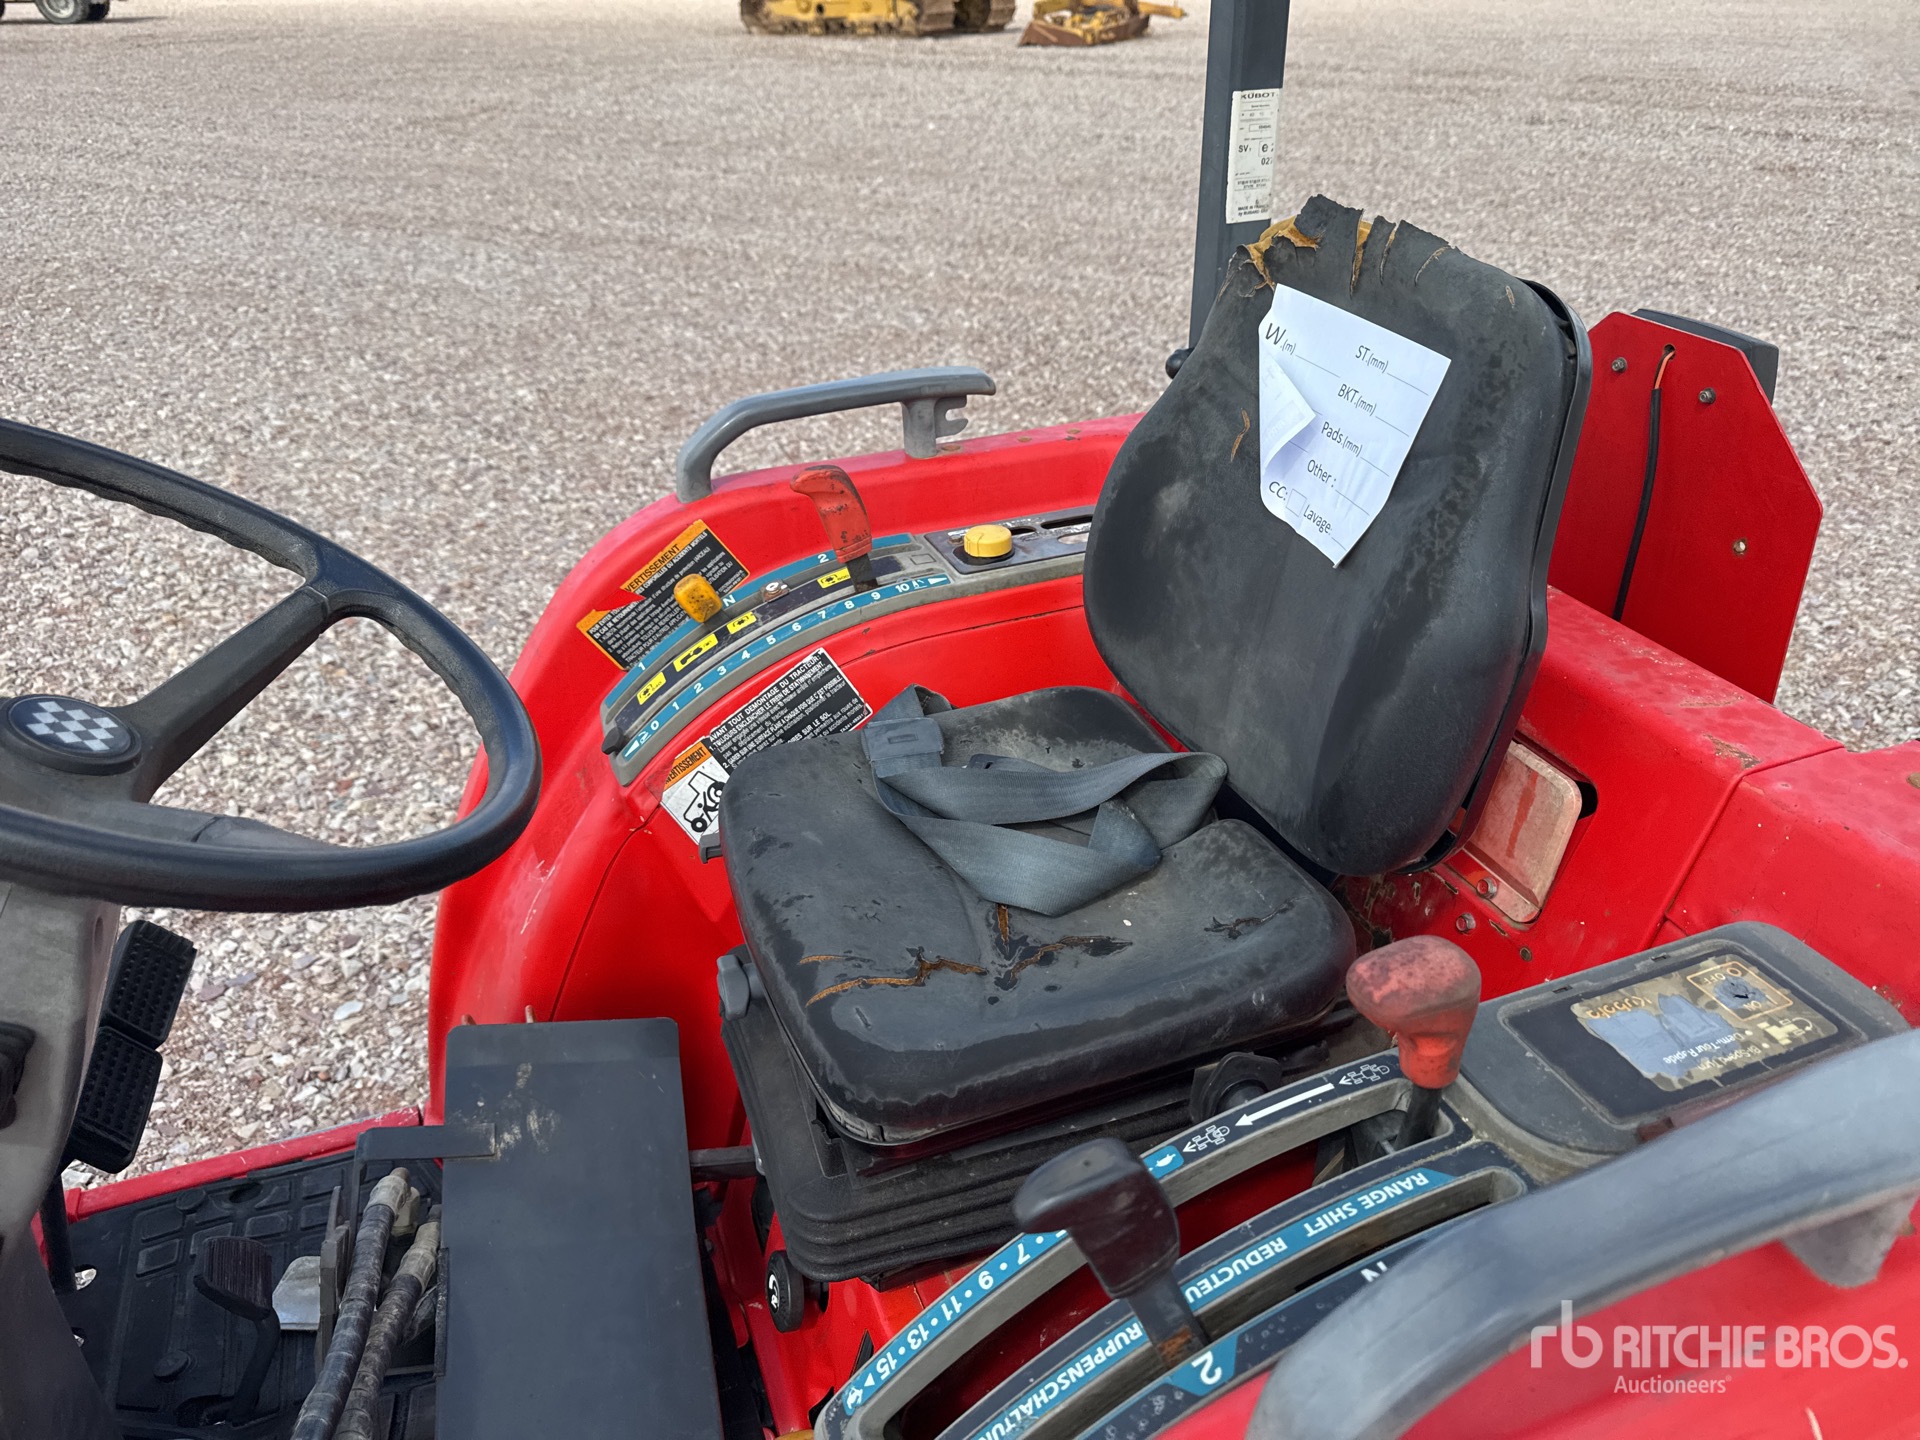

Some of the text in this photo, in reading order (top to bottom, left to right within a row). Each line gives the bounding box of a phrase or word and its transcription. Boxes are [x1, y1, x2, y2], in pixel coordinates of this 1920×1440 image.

[1307, 459, 1332, 484] Other
[625, 543, 681, 592] VERTISSEMENT
[722, 594, 736, 607] N
[817, 553, 830, 563] 2
[650, 583, 910, 731] 0 1 2 3 4 5 6 7 8 9 10
[708, 724, 728, 742] AVANT
[727, 712, 744, 727] TOUT
[744, 685, 779, 714] DEMONTAGE
[779, 678, 789, 688] DU
[1302, 1171, 1430, 1238] RANGE SHIFT
[1184, 1236, 1288, 1304] REDUCTEU
[876, 1242, 1032, 1381] 7 9 11 13 15
[978, 1320, 1144, 1440] RUPPENSCHALTU
[1191, 1350, 1223, 1386] 2
